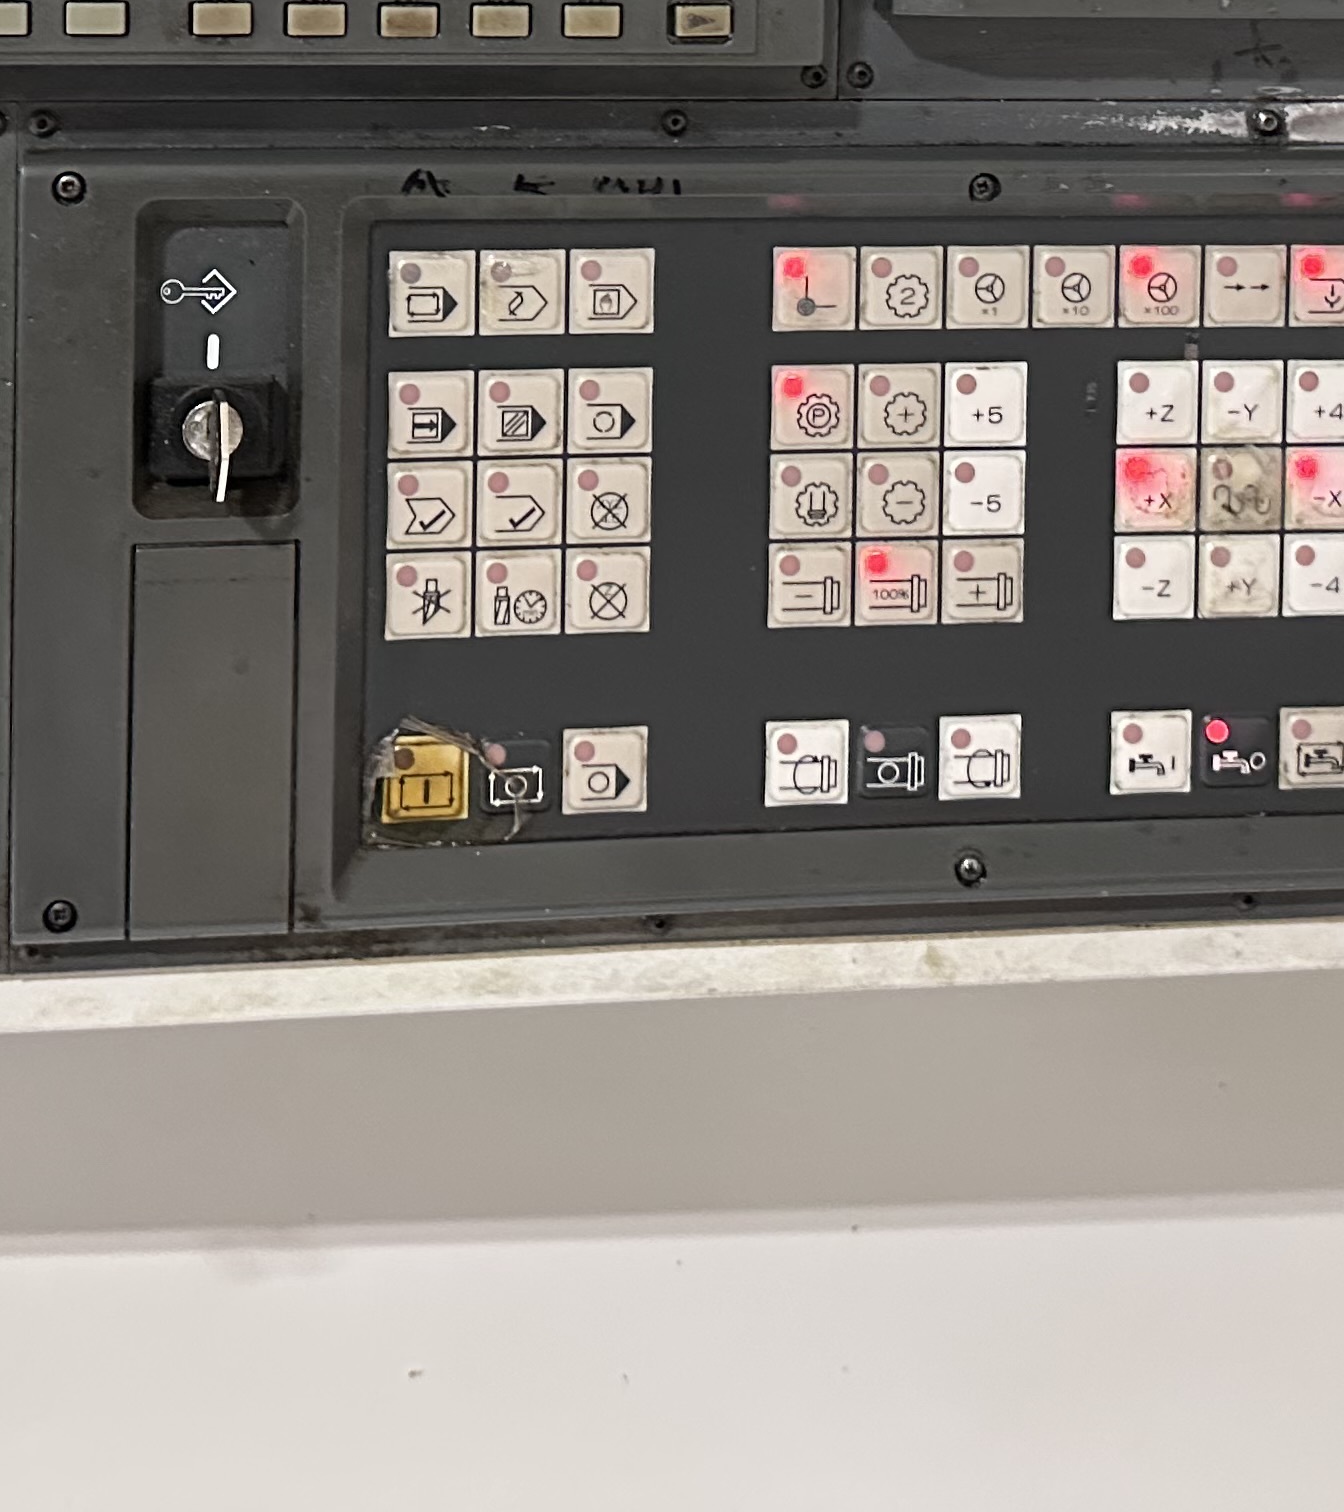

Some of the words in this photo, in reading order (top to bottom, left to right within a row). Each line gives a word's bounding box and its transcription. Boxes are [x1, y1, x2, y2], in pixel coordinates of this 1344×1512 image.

[900, 288, 916, 306] 2
[972, 406, 1003, 424] +5
[1145, 405, 1175, 422] +Z
[1315, 403, 1344, 420] +4
[970, 494, 1002, 513] -5
[1143, 493, 1172, 509] +X
[1311, 577, 1340, 593] -4
